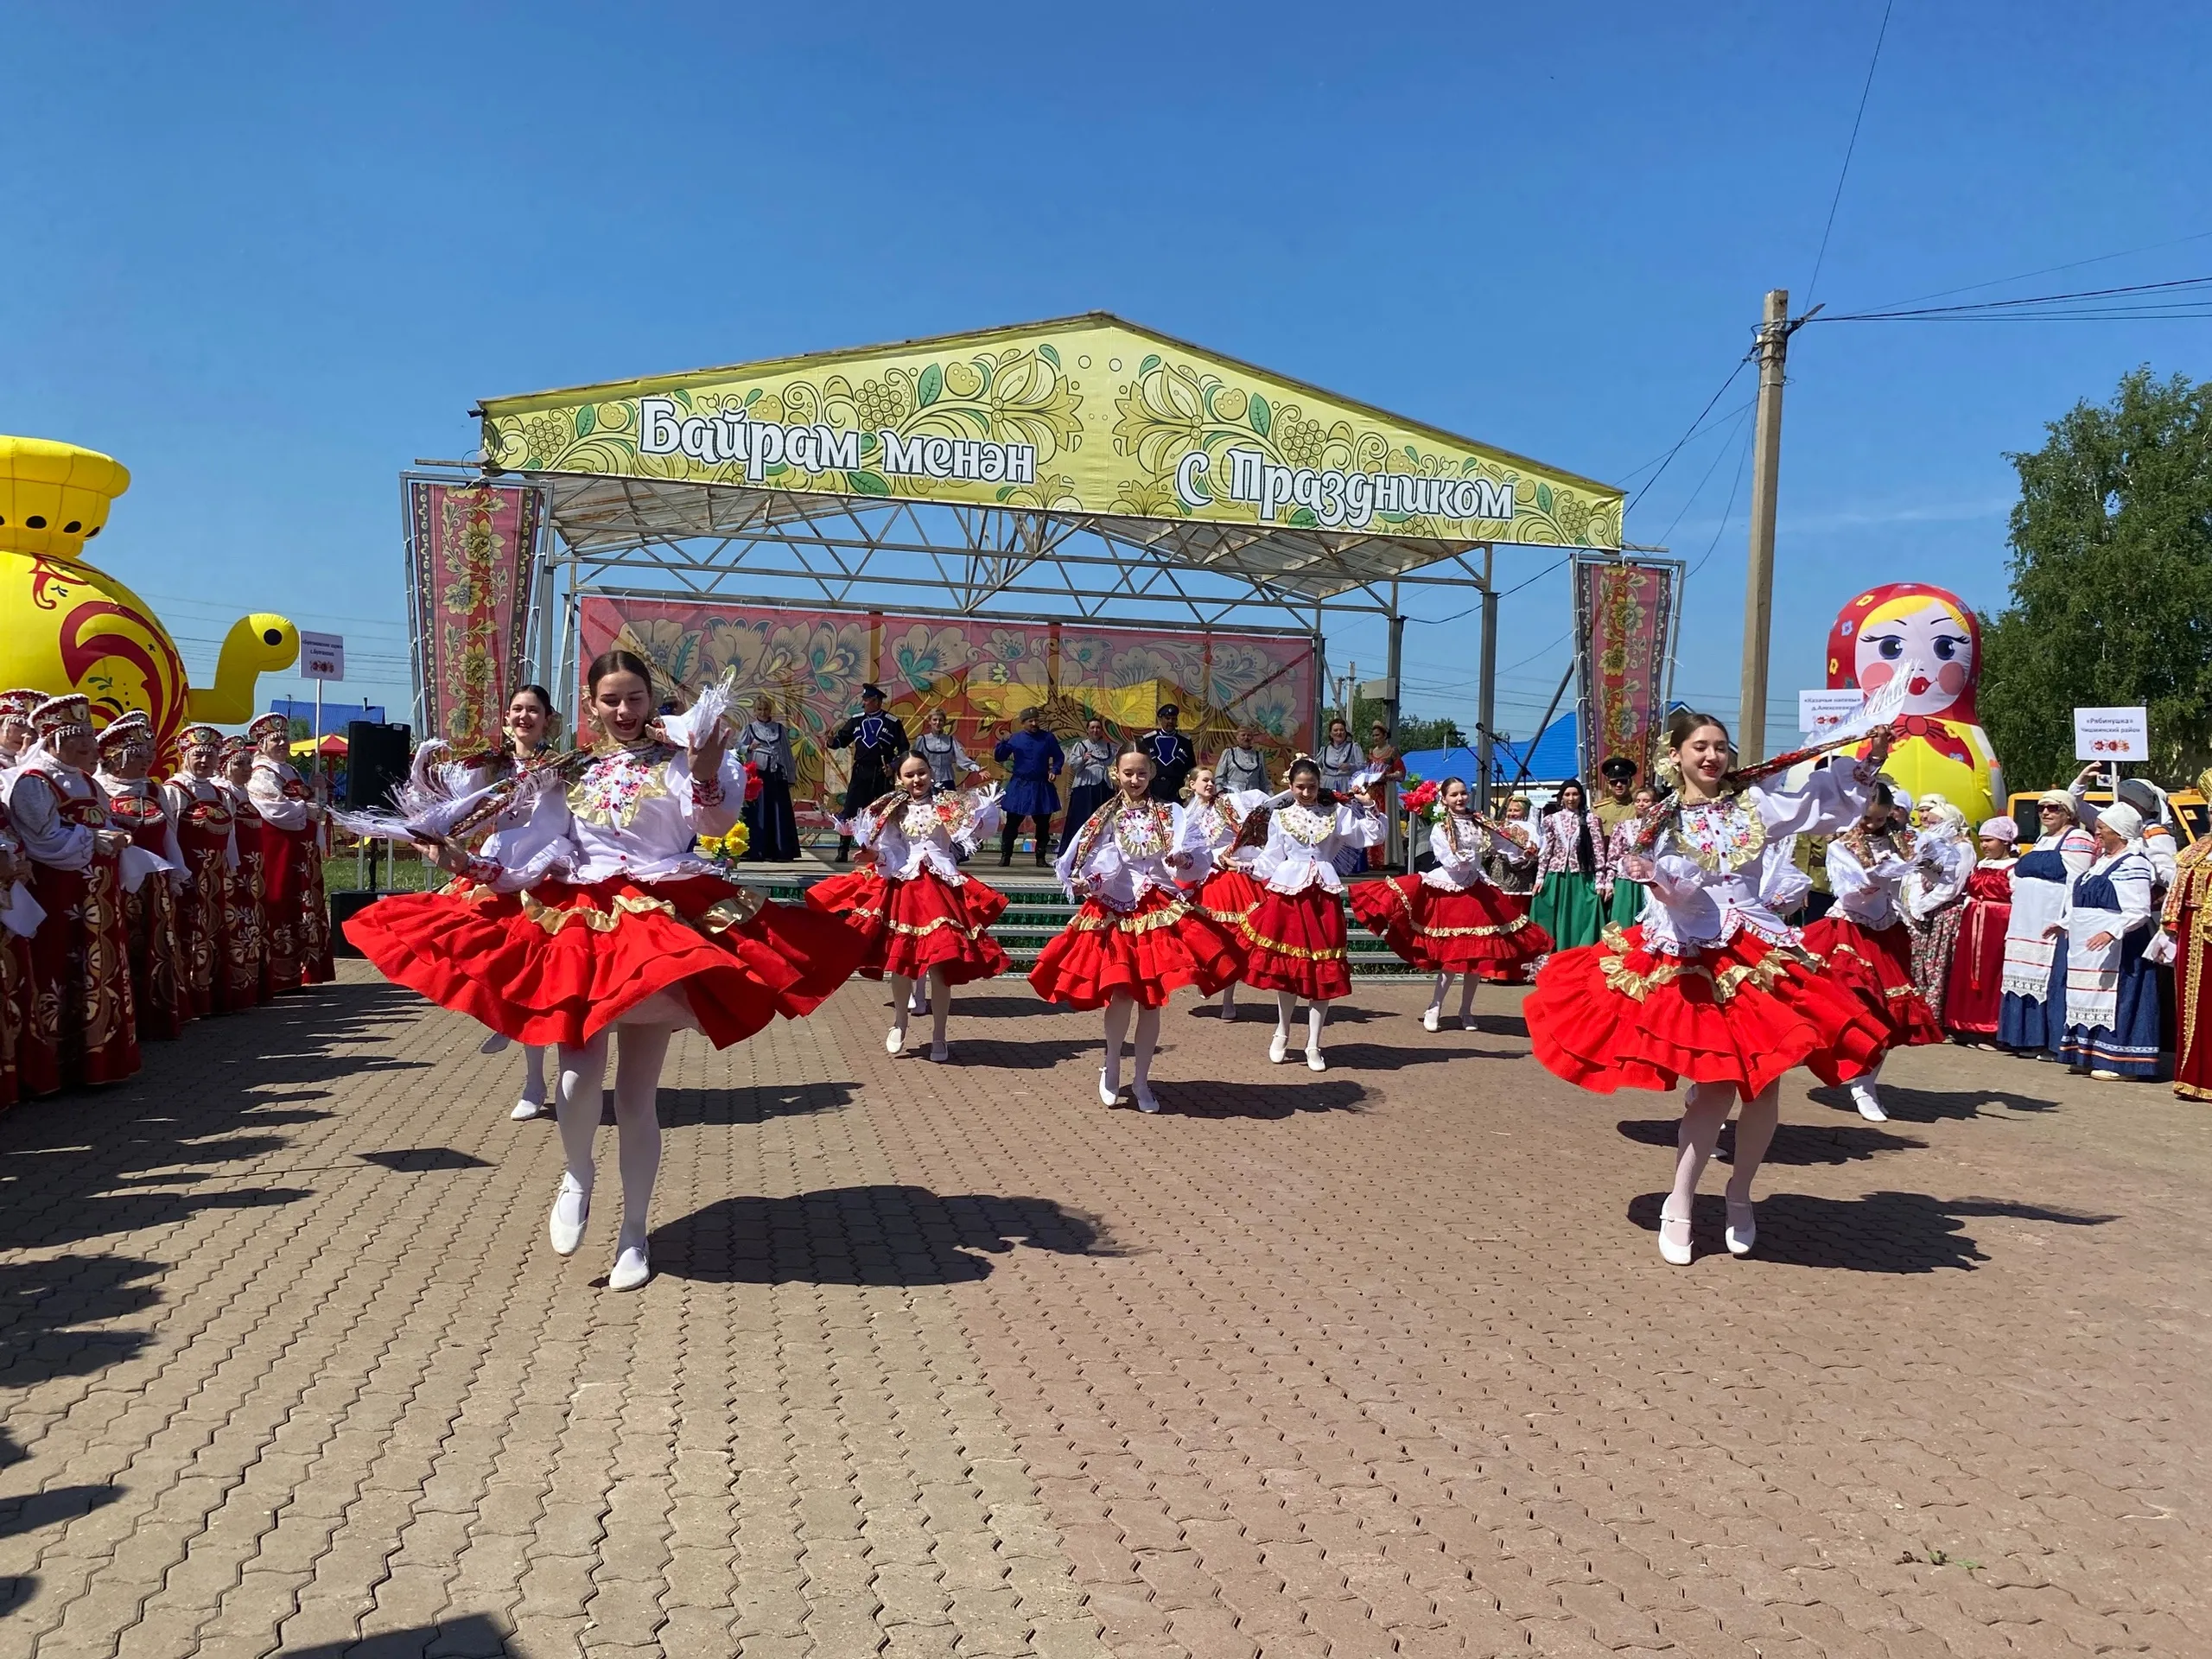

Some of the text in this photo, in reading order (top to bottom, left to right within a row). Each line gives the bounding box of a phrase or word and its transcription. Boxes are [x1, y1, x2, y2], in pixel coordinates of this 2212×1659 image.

[640, 397, 1036, 484] Байрам менән
[1227, 448, 1514, 528] Праздником
